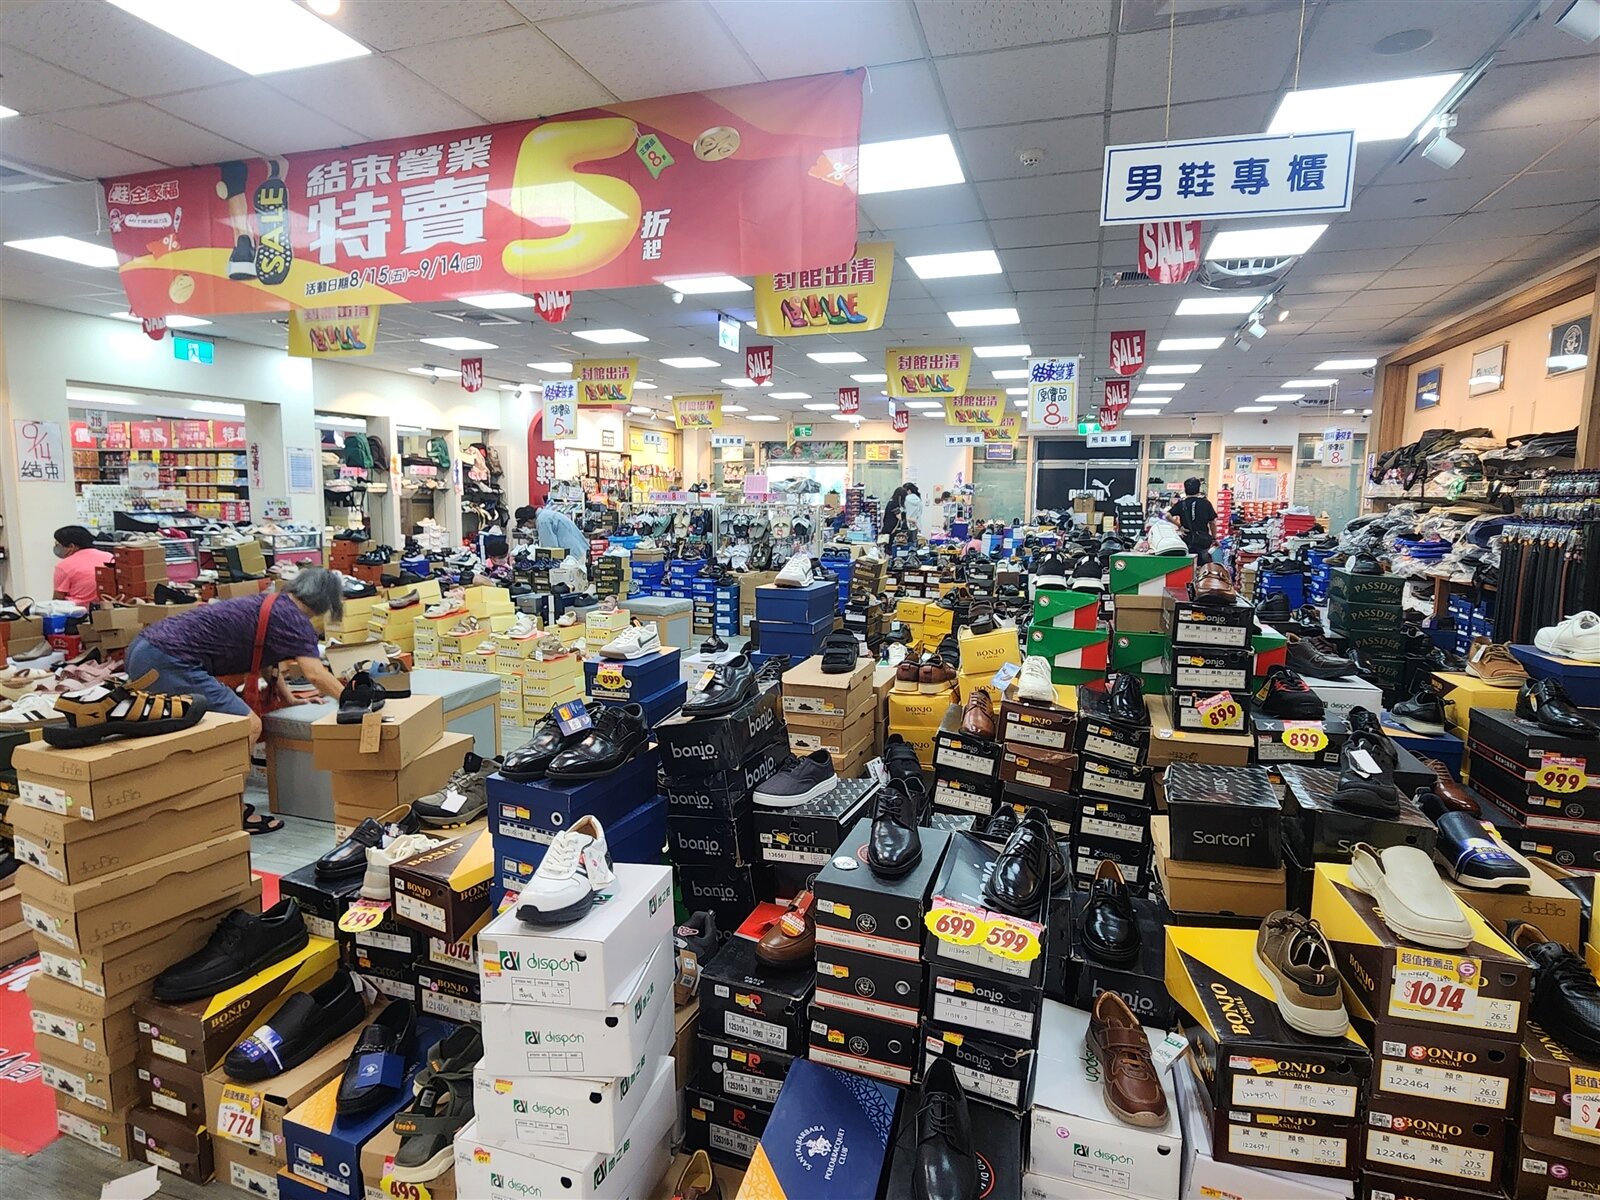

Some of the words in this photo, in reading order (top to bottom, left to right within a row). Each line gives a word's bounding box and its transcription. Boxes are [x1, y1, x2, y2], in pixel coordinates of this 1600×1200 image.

[306, 133, 494, 197] 結束營業
[647, 149, 662, 168] 8
[1126, 153, 1328, 203] 男鞋專櫃
[502, 117, 642, 280] 5
[307, 174, 490, 265] 特賣
[260, 186, 286, 275] SALE
[640, 207, 672, 261] 折起
[1143, 220, 1196, 270] SALE
[773, 258, 876, 291] 封館出清
[1112, 335, 1142, 369] SALE
[748, 353, 771, 380] SALE
[898, 354, 960, 371] 封館出清
[463, 363, 481, 388] SALE
[582, 366, 630, 380] 封館出清
[1030, 362, 1075, 383] 結束營業
[840, 391, 859, 411] SALE
[953, 396, 998, 407] 封館出清
[1106, 384, 1128, 406] SALE
[893, 413, 909, 429] SALE
[1100, 409, 1117, 428] SALE
[21, 461, 59, 479] 結束
[1354, 582, 1400, 595] PASSDER
[1351, 609, 1397, 622] PASSDER
[976, 647, 1005, 658] BONJO
[602, 673, 621, 686] 899
[1209, 704, 1236, 726] 899
[1289, 732, 1319, 748] 899
[1544, 771, 1580, 790] 999
[1193, 830, 1251, 847] Sartori
[407, 882, 431, 897] BONJO
[936, 914, 975, 939] 699
[986, 926, 1028, 953] 599
[1402, 953, 1454, 971] 超值推薦品
[437, 979, 469, 994] BONJO
[210, 1000, 251, 1029] BONJO
[1211, 983, 1251, 1036] BONJO
[1234, 996, 1255, 1024] CASUAL
[1489, 1002, 1512, 1011] 尺寸
[1491, 1013, 1508, 1021] 26.5
[1277, 1060, 1326, 1075] ONJO
[1429, 1058, 1462, 1068] CASUAL
[1278, 1070, 1311, 1079] CASUAL
[1389, 1076, 1430, 1090] 122464
[1478, 1077, 1500, 1086] 尺寸
[1326, 1086, 1349, 1095] 尺寸
[1480, 1087, 1497, 1097] 26.0
[1474, 1096, 1500, 1106] 25.0-27.5
[1414, 1130, 1448, 1140] CASUAL
[1376, 1148, 1416, 1161] 122464
[1464, 1149, 1486, 1160] 尺寸
[1460, 1167, 1486, 1178] 25.0-27.5
[1464, 1159, 1482, 1169] 27.5
[390, 1181, 420, 1200] 499
